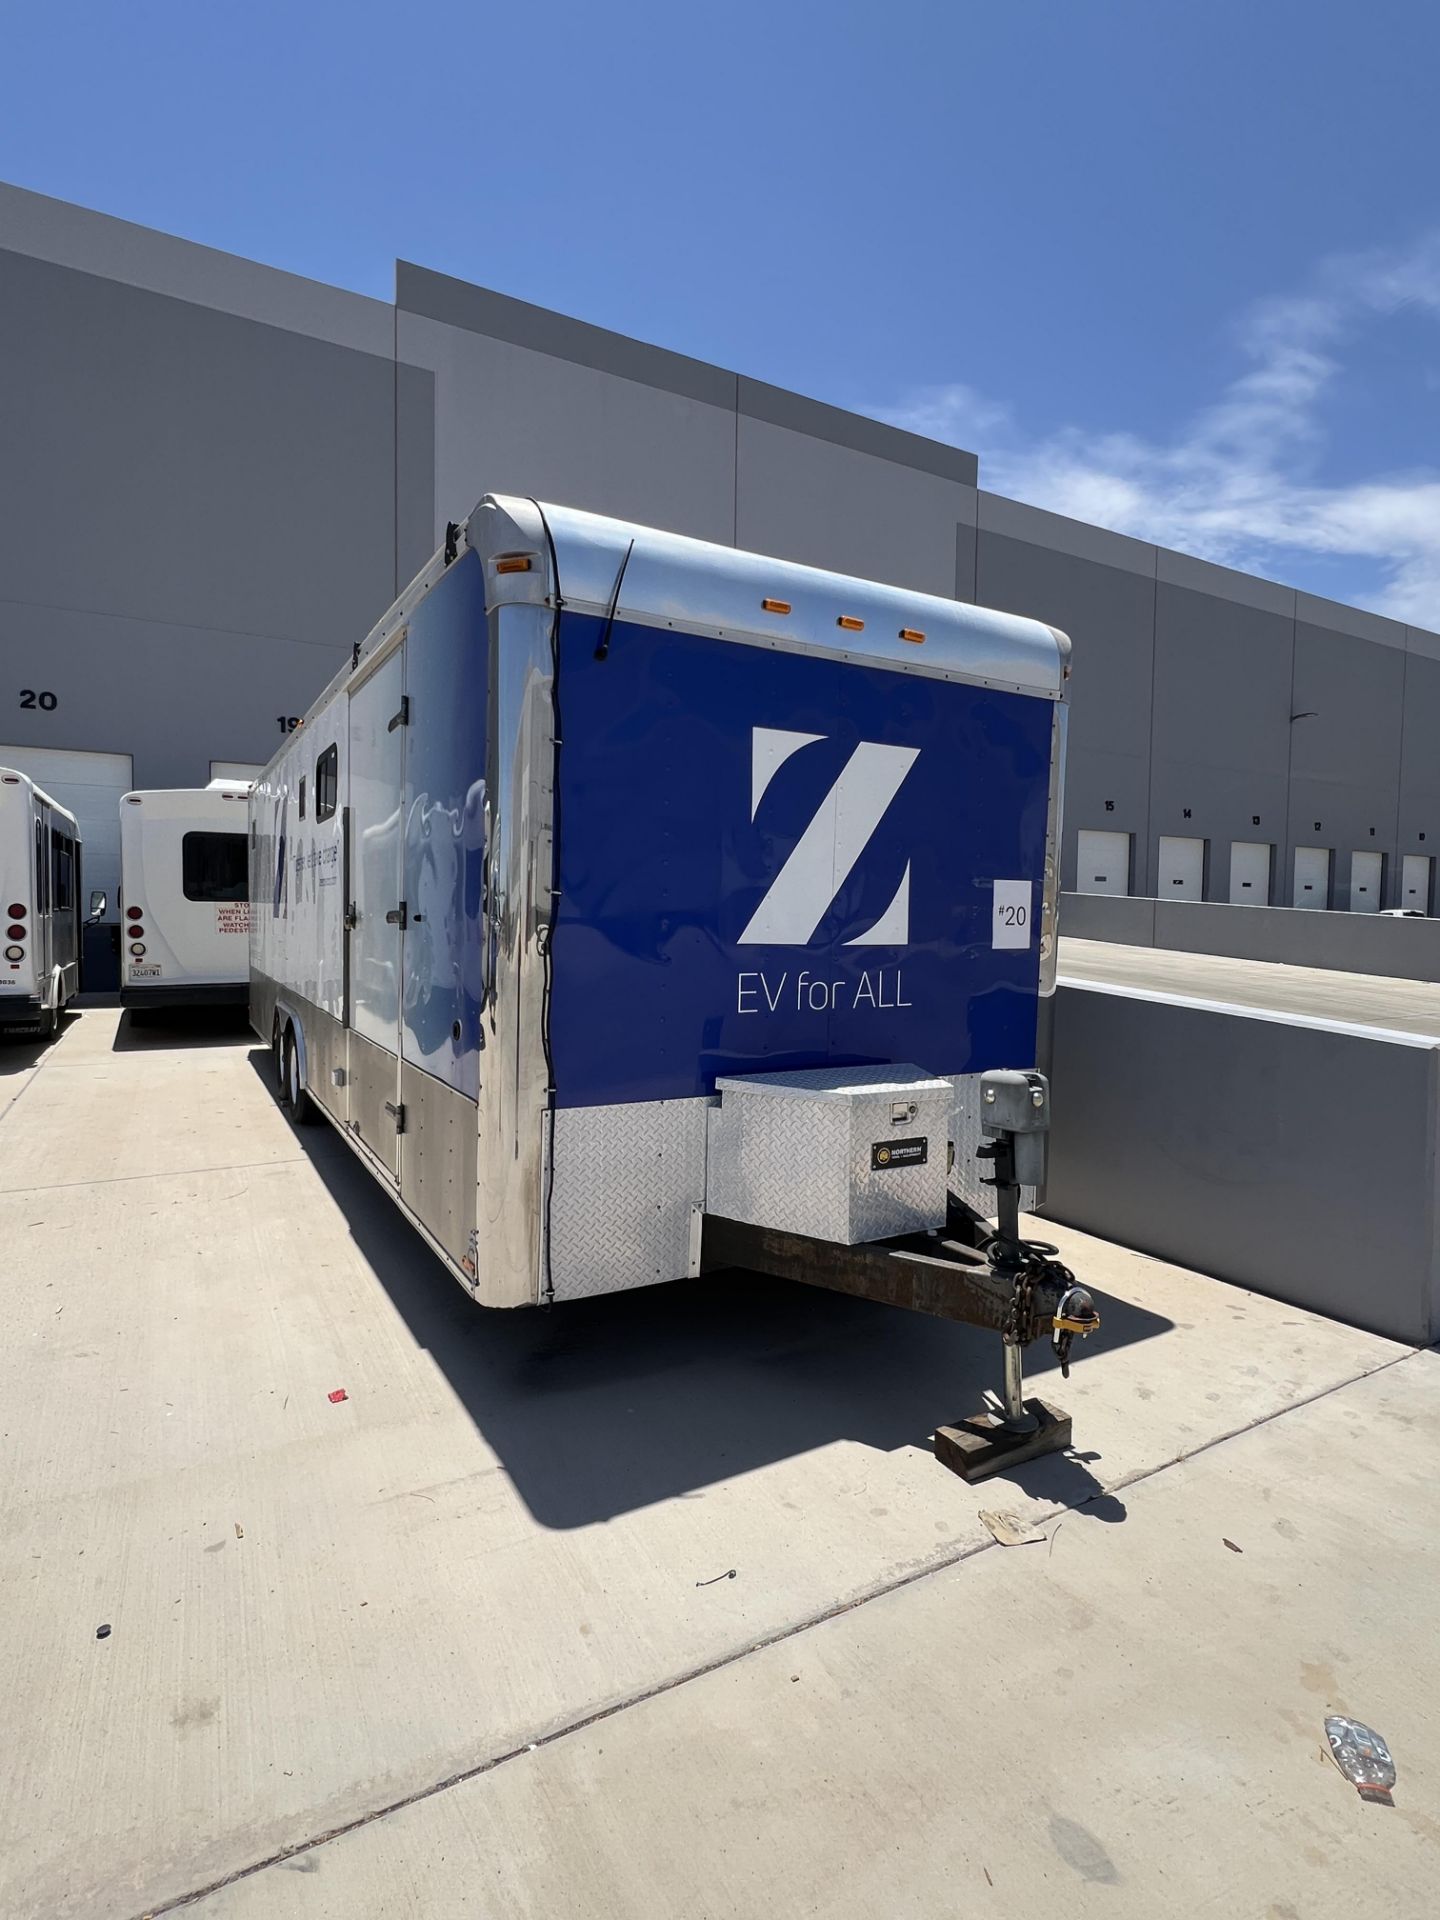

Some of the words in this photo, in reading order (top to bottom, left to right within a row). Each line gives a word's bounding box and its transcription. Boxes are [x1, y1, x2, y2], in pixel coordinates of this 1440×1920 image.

[20, 689, 57, 711] 20
[277, 716, 304, 733] 19
[1105, 800, 1114, 811] 15
[1183, 809, 1191, 818] 14
[998, 905, 1027, 927] #20
[737, 971, 788, 1014] EV
[797, 970, 846, 1011] for
[852, 969, 913, 1009] ALL
